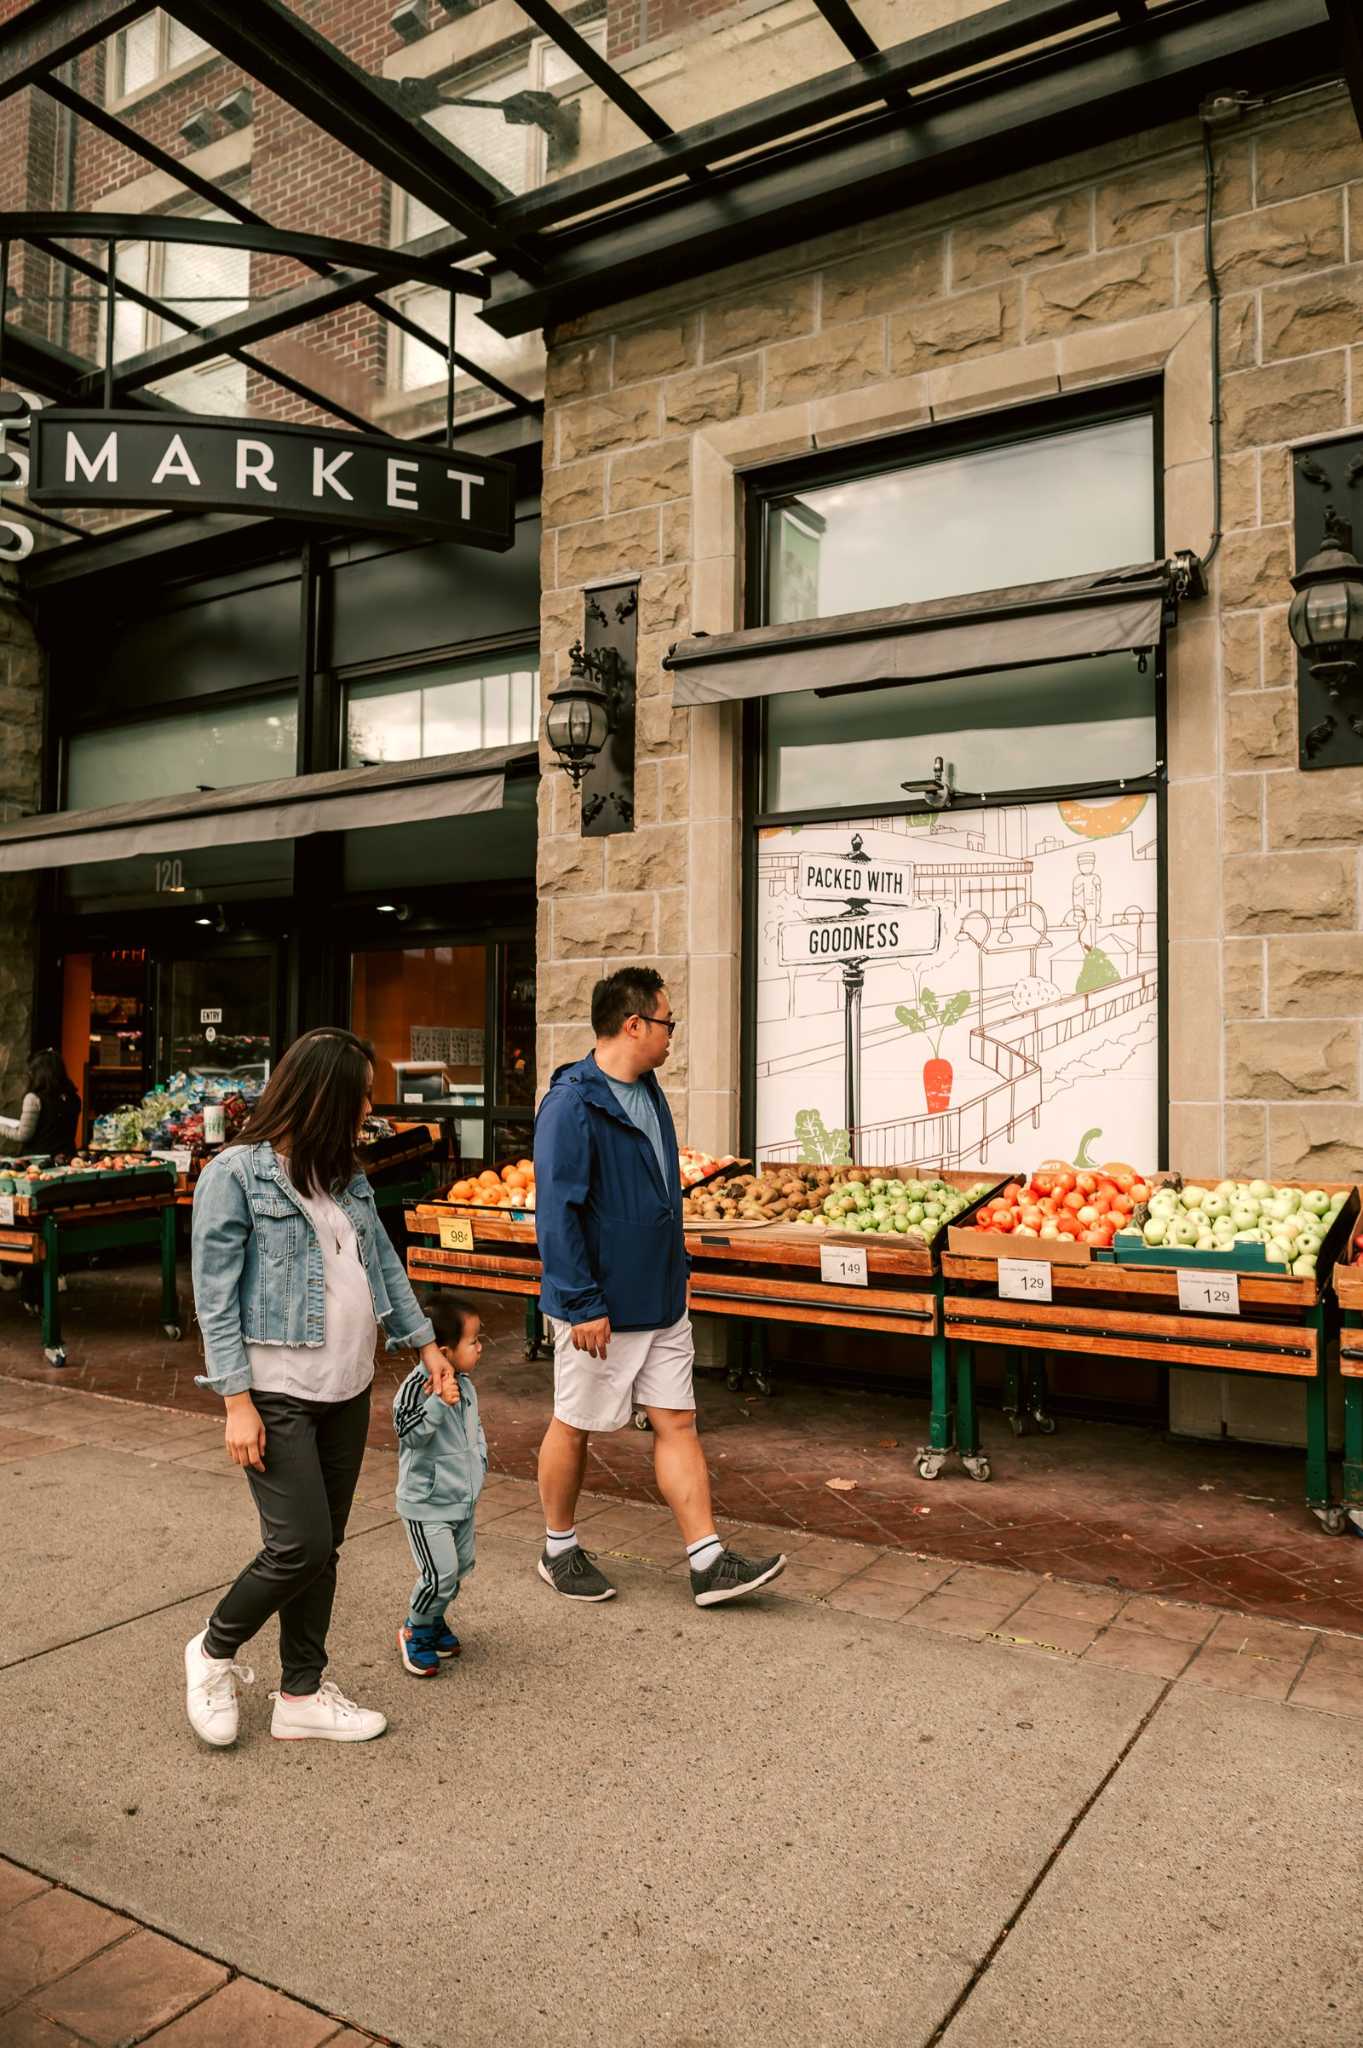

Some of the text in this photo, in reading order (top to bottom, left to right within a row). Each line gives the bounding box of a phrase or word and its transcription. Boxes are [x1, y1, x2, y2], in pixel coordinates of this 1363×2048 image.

[65, 431, 485, 520] MARKET
[155, 859, 183, 892] 120
[807, 866, 903, 894] PACKED WITH
[809, 922, 899, 954] GOODNESS
[203, 1011, 221, 1021] ENTRY
